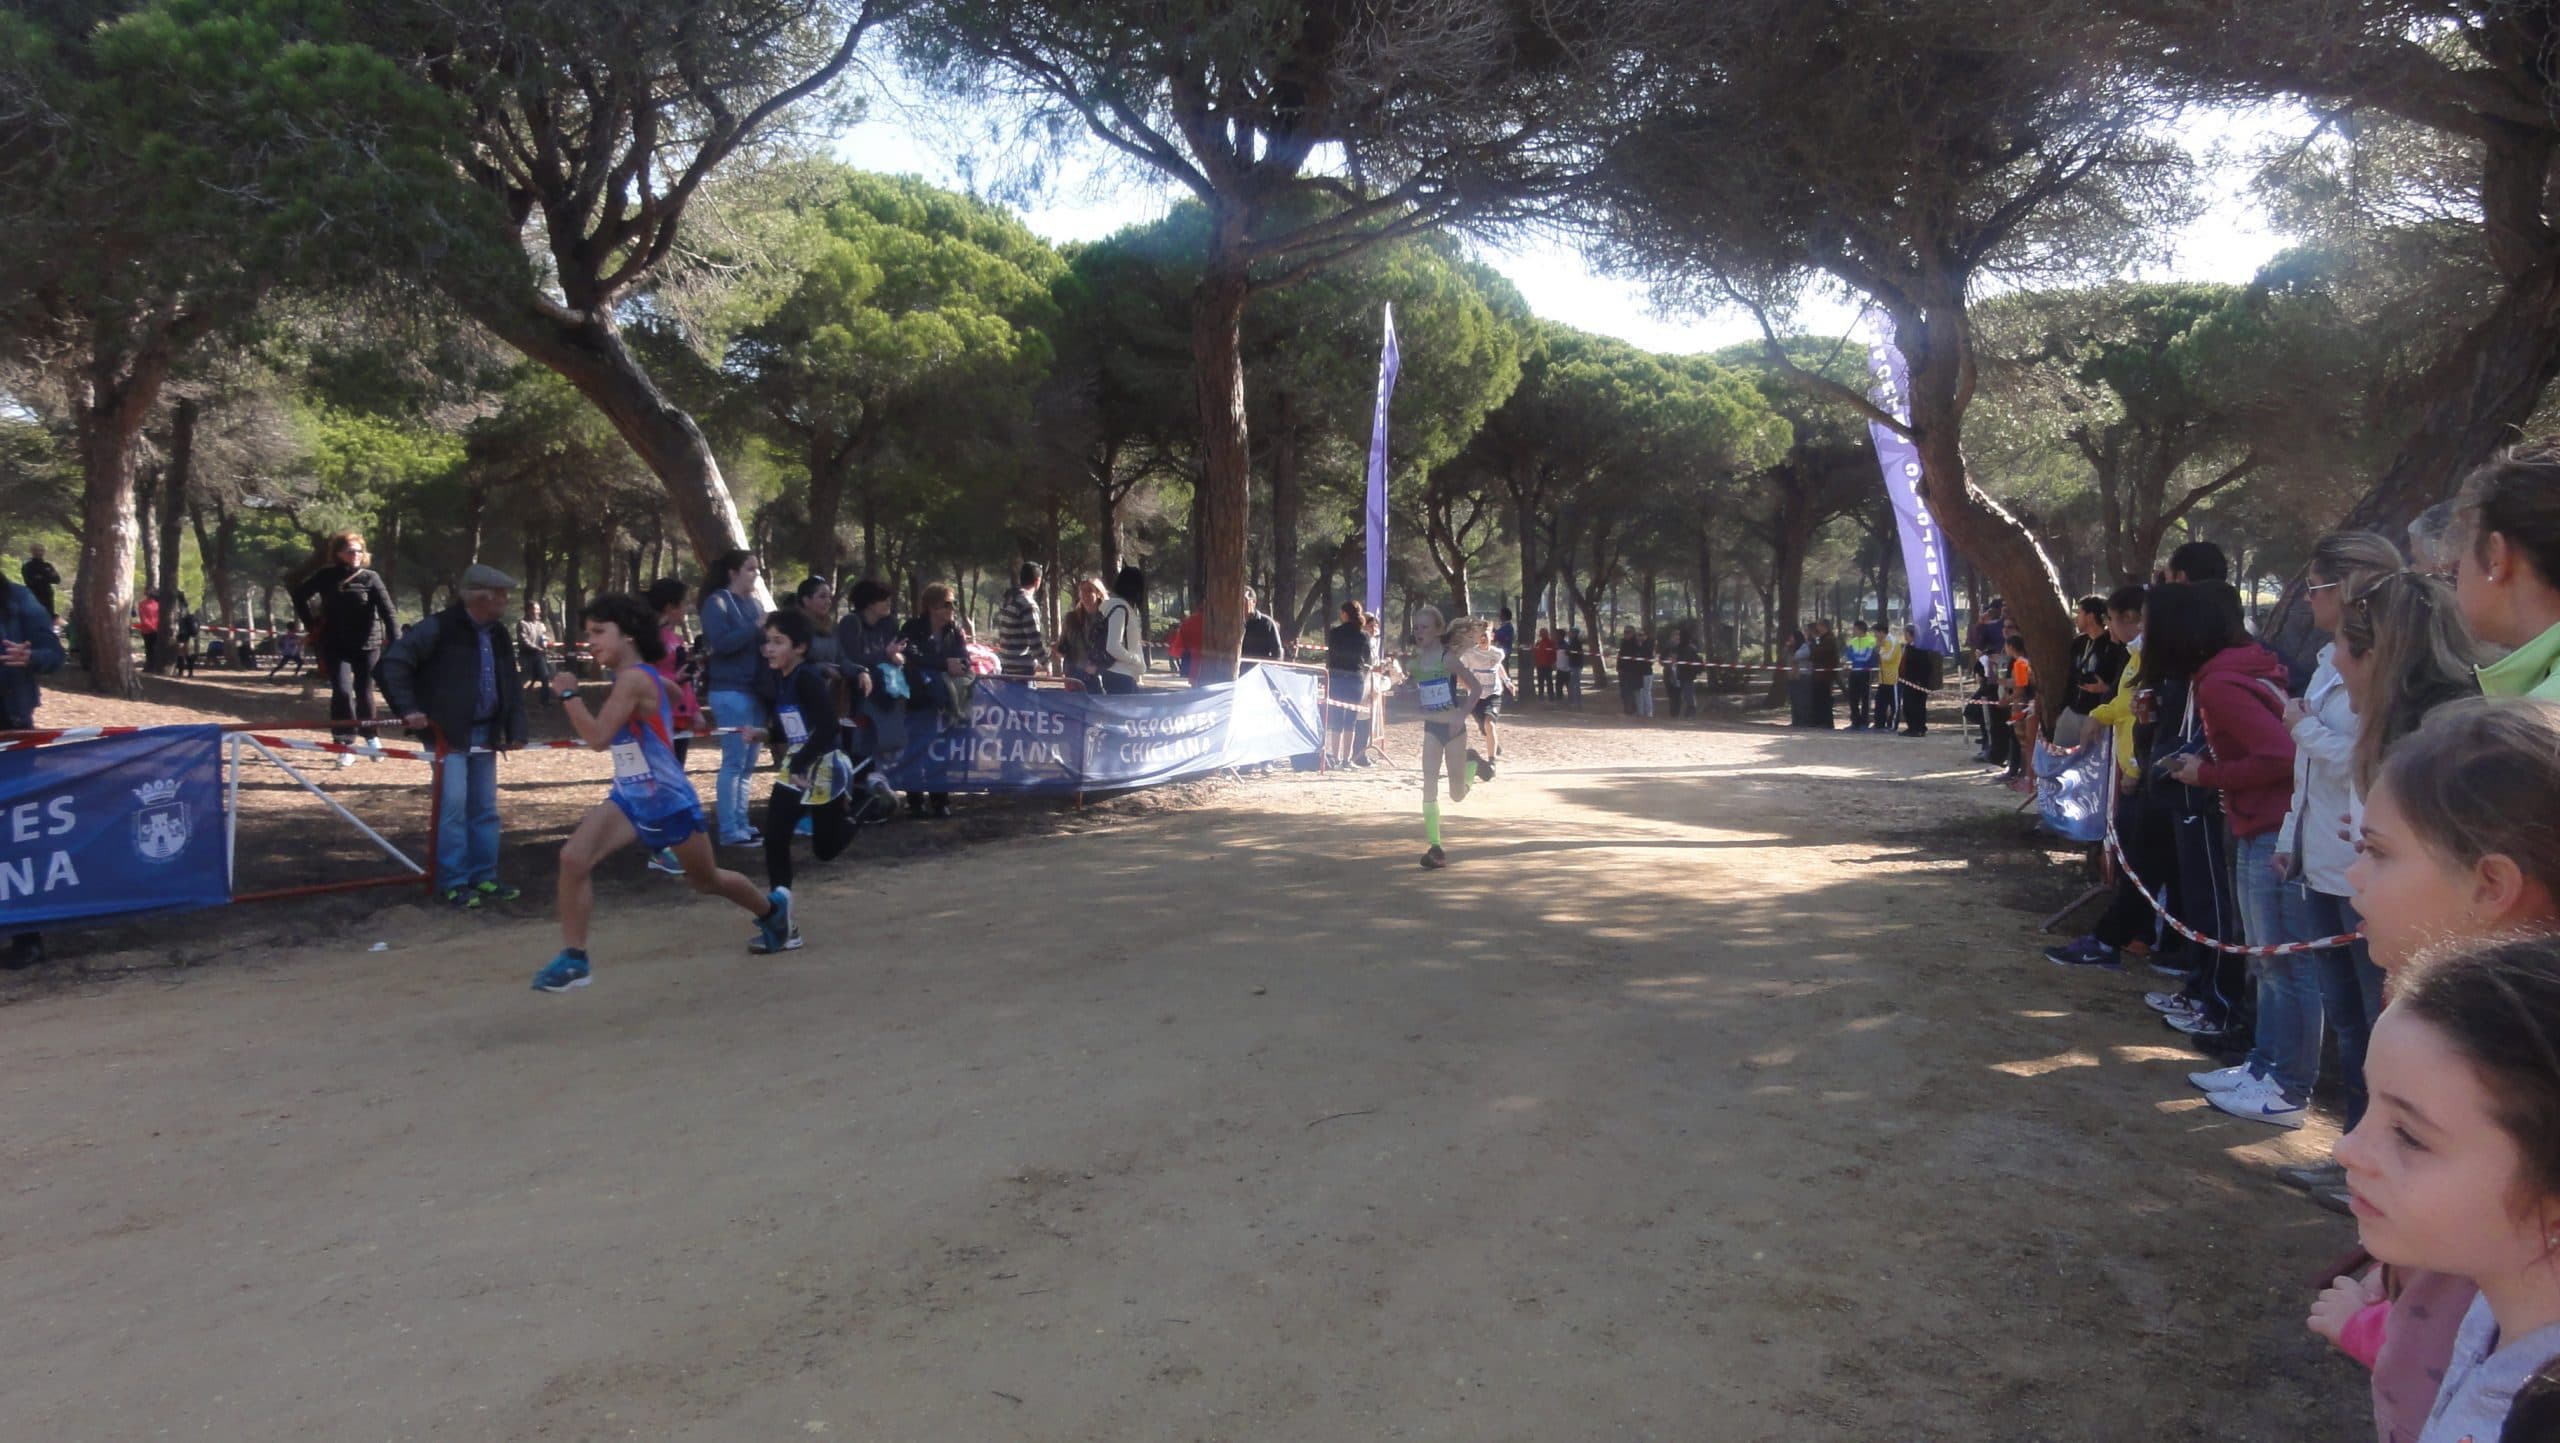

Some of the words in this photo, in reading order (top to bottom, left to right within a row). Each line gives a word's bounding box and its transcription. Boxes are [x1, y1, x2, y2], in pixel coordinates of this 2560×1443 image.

[936, 705, 1065, 735] PORTES
[928, 737, 1063, 763] CHICLANA
[1120, 737, 1211, 764] CHICLANA
[0, 795, 76, 843] ES
[0, 850, 80, 901] NA
